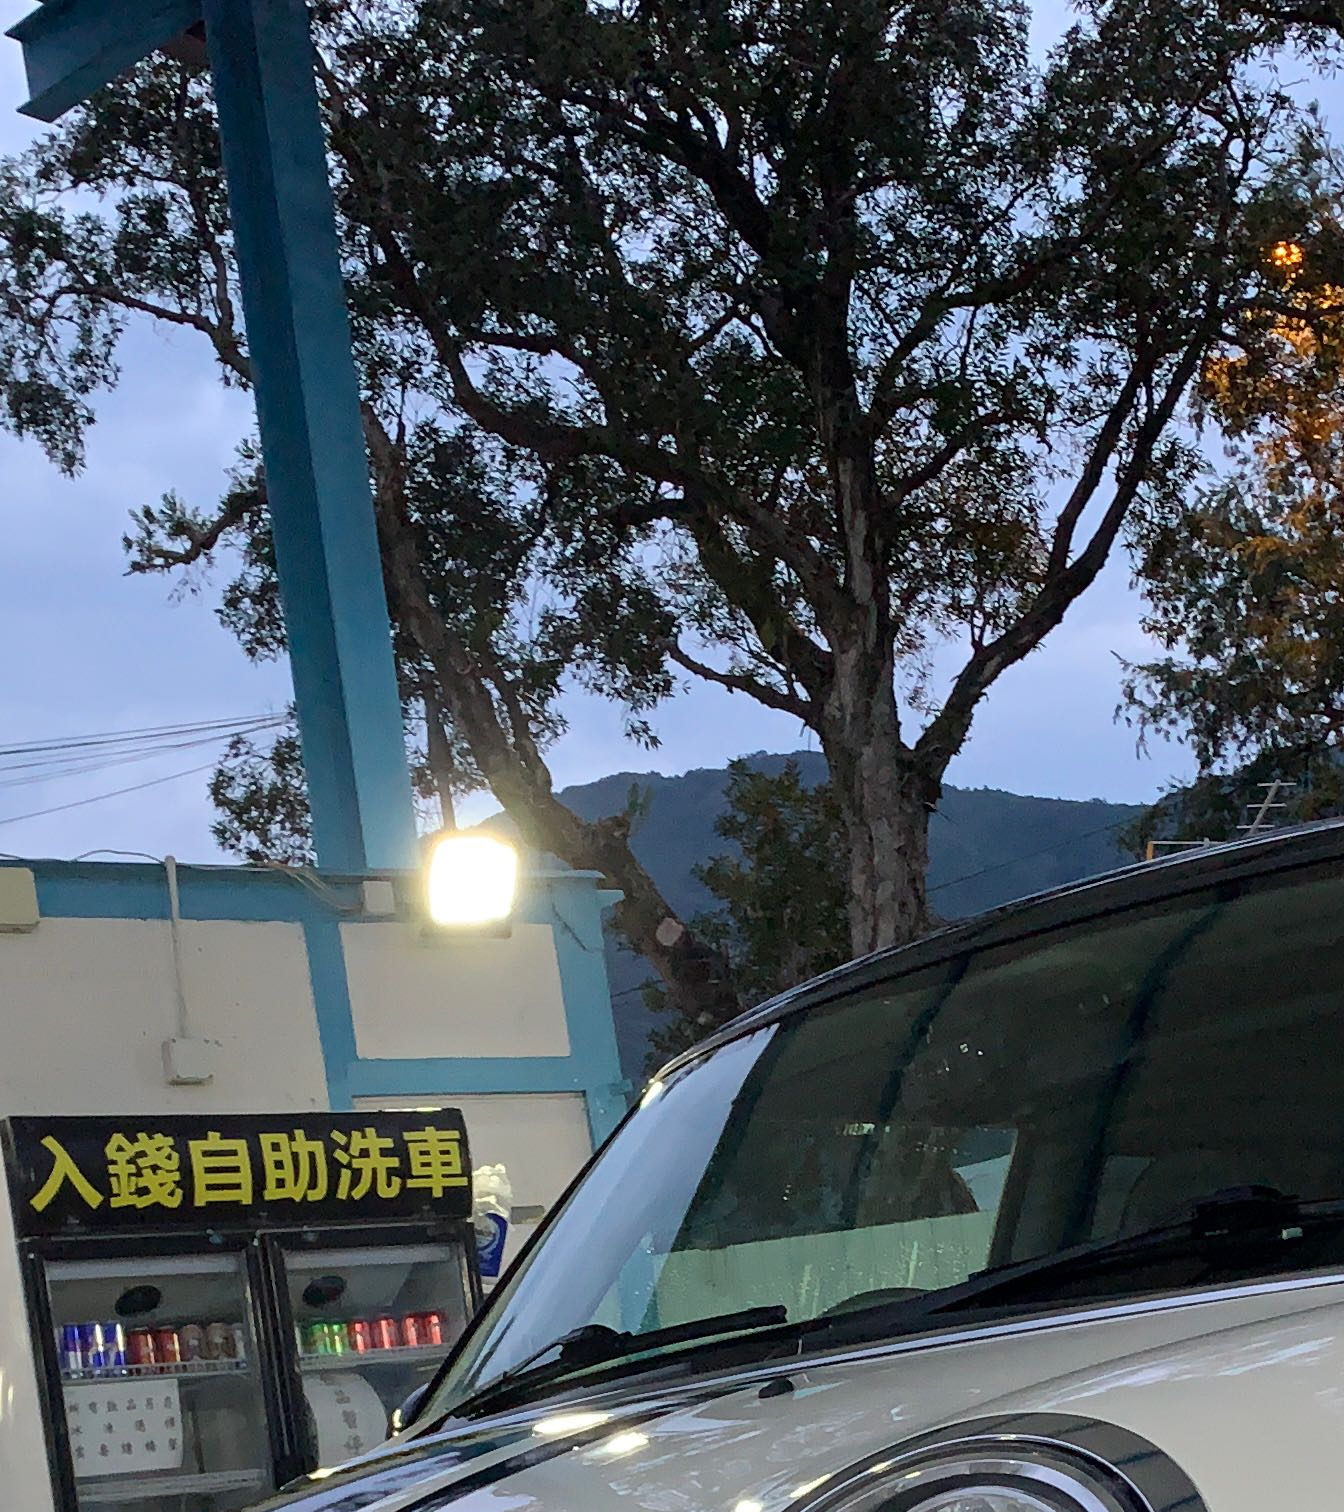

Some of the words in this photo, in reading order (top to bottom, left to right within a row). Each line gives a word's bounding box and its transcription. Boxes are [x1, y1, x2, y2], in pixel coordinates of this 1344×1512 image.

[29, 1126, 469, 1212] 入錢自助洗車
